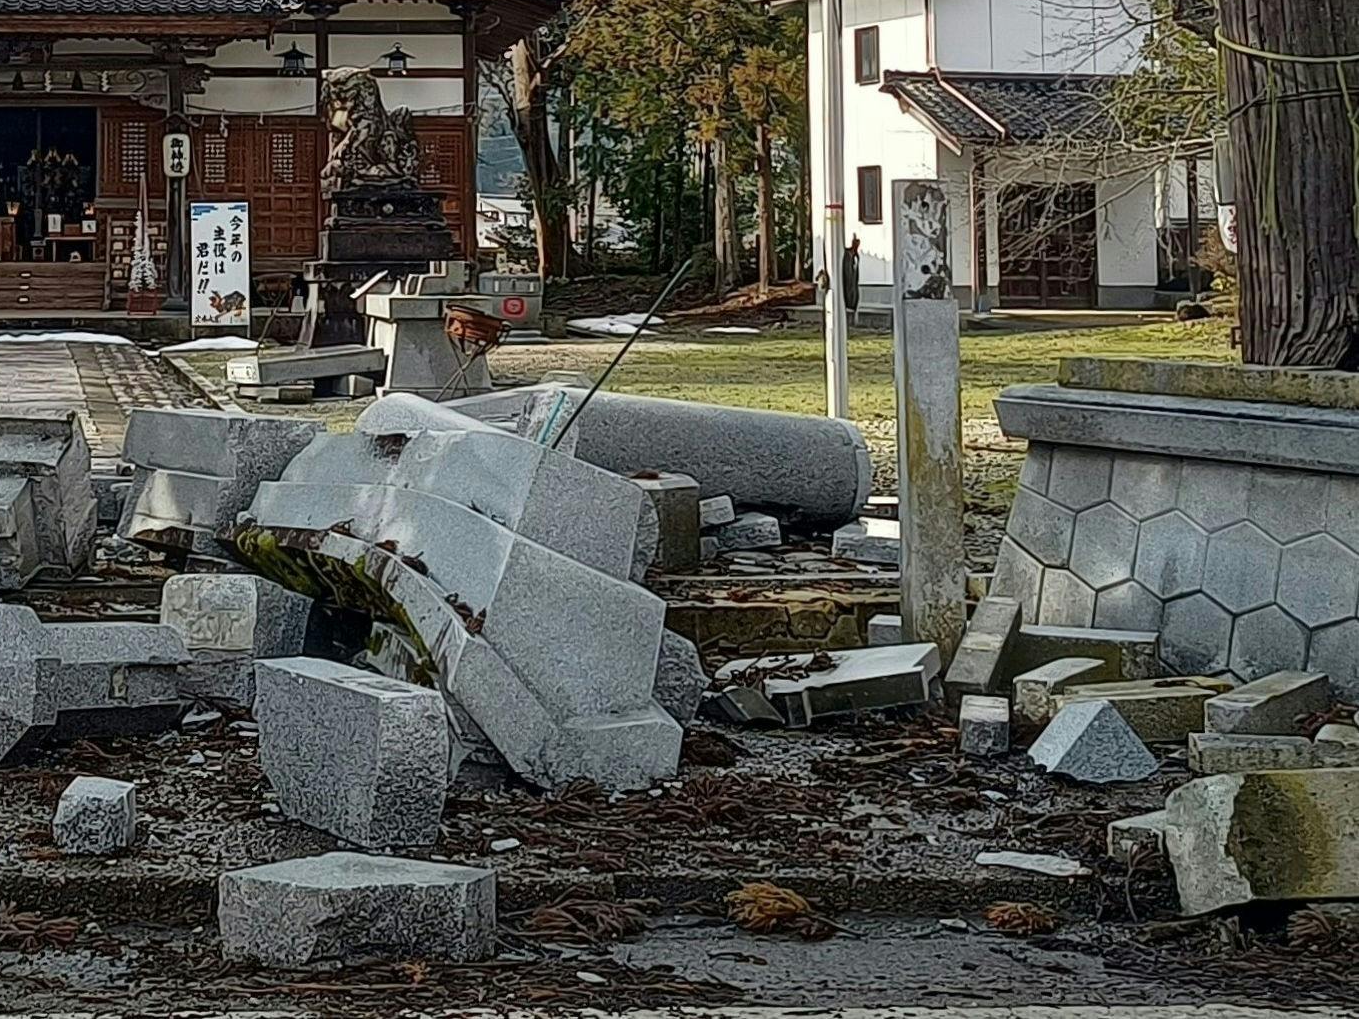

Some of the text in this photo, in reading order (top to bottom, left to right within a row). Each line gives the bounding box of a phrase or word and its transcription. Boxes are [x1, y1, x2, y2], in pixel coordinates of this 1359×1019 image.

[213, 225, 226, 275] 主役は
[230, 215, 243, 263] 今年の
